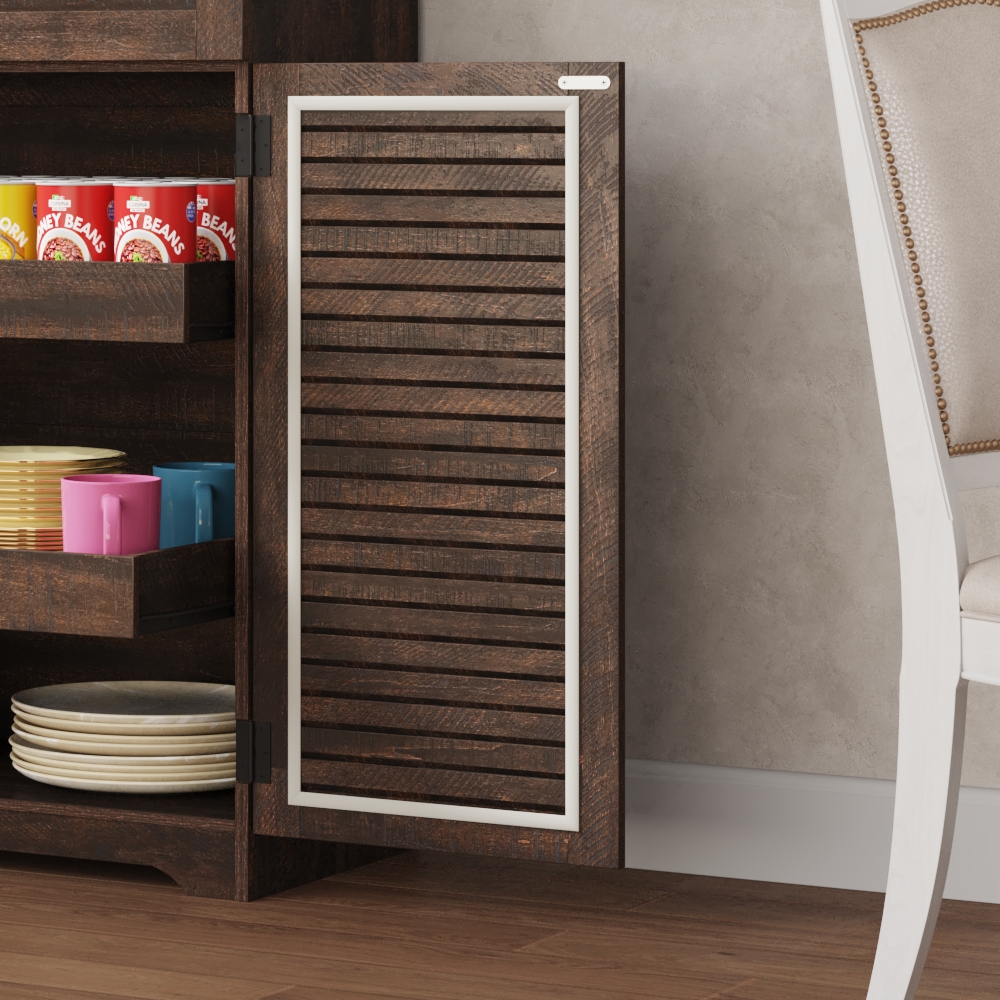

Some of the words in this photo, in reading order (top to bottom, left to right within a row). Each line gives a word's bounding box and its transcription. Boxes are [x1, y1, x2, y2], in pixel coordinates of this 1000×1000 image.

[37, 212, 61, 238] DNEY
[64, 213, 106, 254] BEANS
[114, 213, 140, 240] DNEY
[142, 214, 185, 256] BEANS
